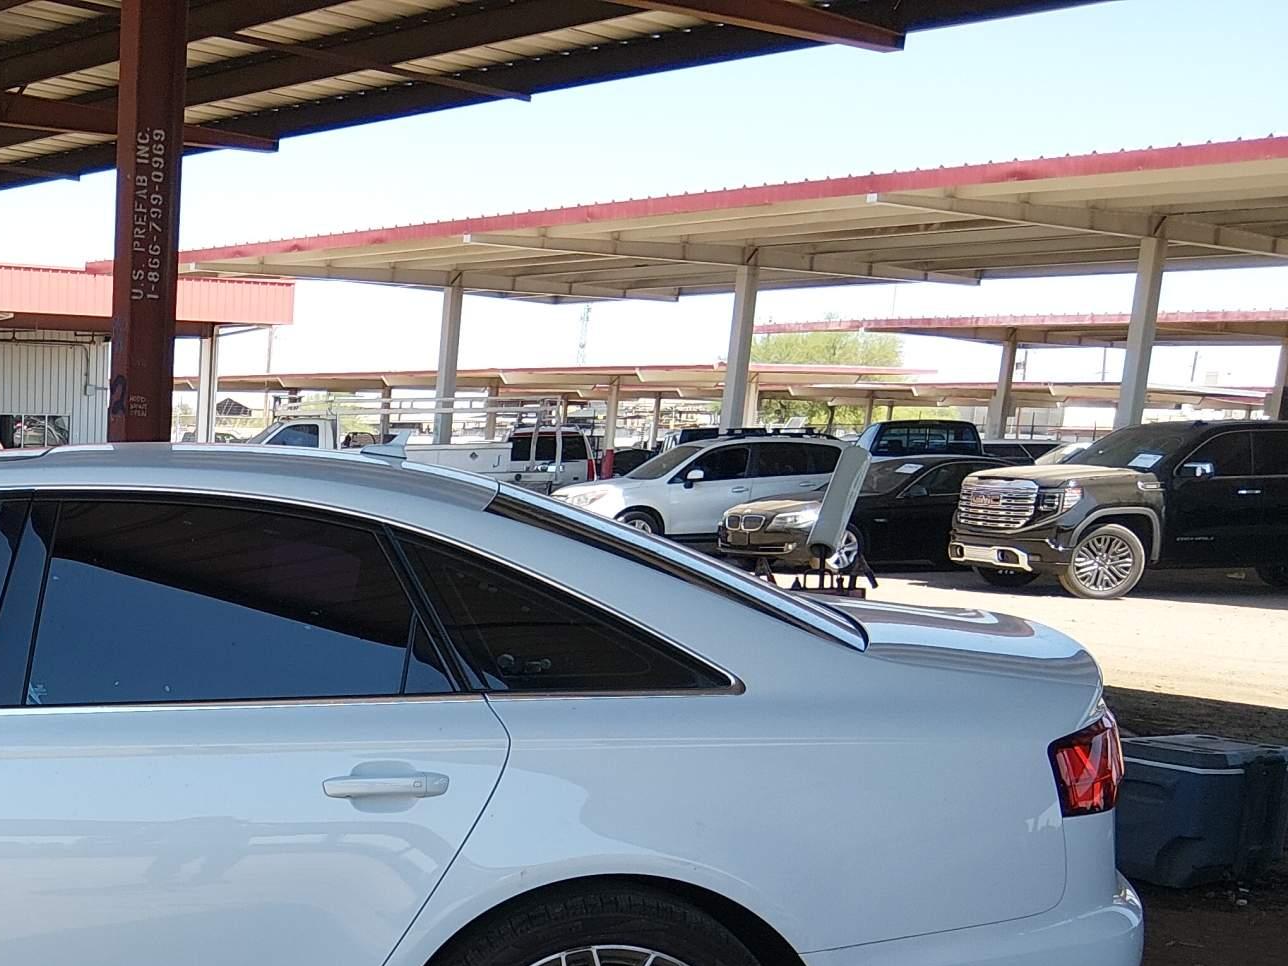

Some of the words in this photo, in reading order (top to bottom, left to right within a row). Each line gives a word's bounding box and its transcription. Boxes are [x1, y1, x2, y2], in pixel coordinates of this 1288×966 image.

[136, 127, 150, 164] INC.
[133, 175, 148, 252] PREFAB
[147, 128, 165, 299] 1-866-799-0969
[131, 263, 145, 300] U.S.
